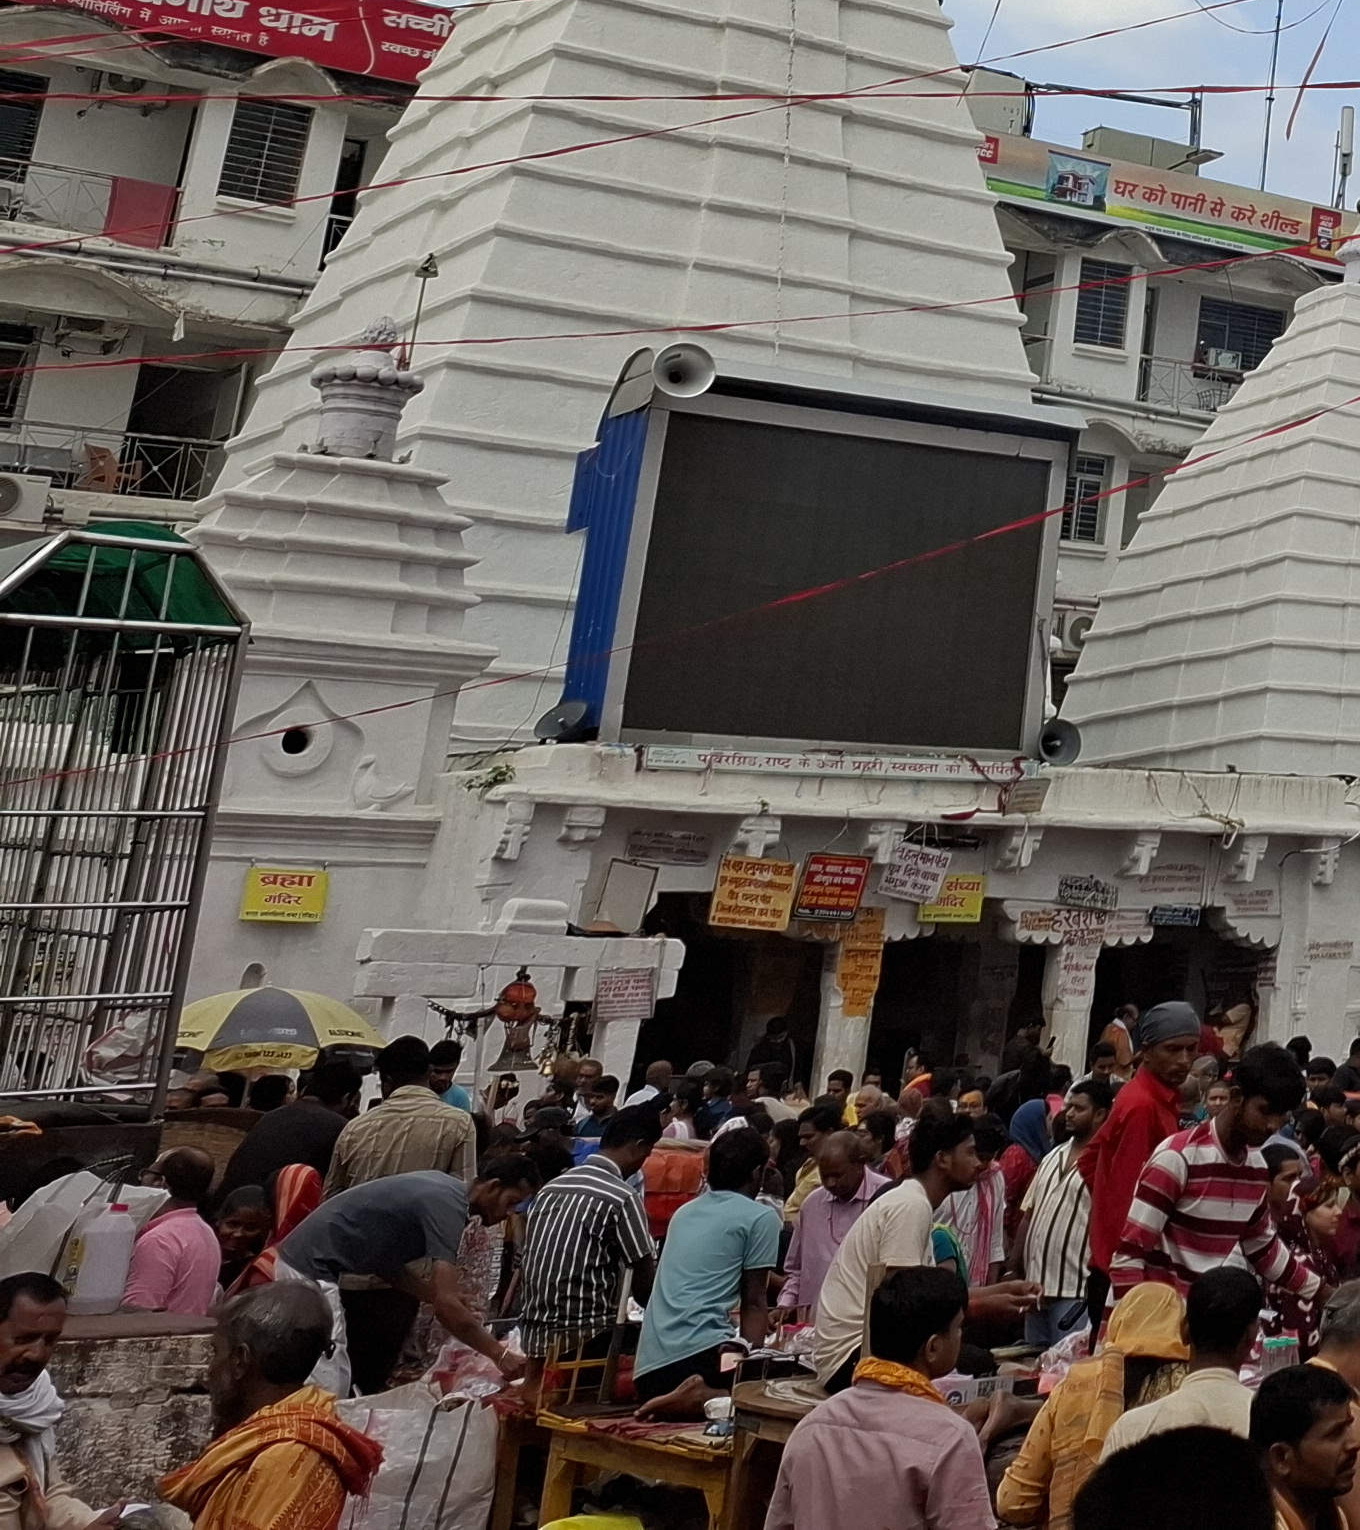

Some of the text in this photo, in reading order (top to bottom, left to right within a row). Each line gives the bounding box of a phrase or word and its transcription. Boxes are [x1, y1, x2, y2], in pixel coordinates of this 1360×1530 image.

[258, 6, 339, 42] धाम
[1113, 179, 1139, 200] घर
[1142, 183, 1167, 206] को
[1171, 191, 1209, 216] पानी
[1211, 195, 1227, 218] से
[1259, 209, 1303, 236] शील्ड
[891, 761, 939, 774] स्वच्छता
[945, 762, 960, 774] को
[259, 873, 316, 888] ब्रह्मा
[264, 892, 304, 905] मंदिर
